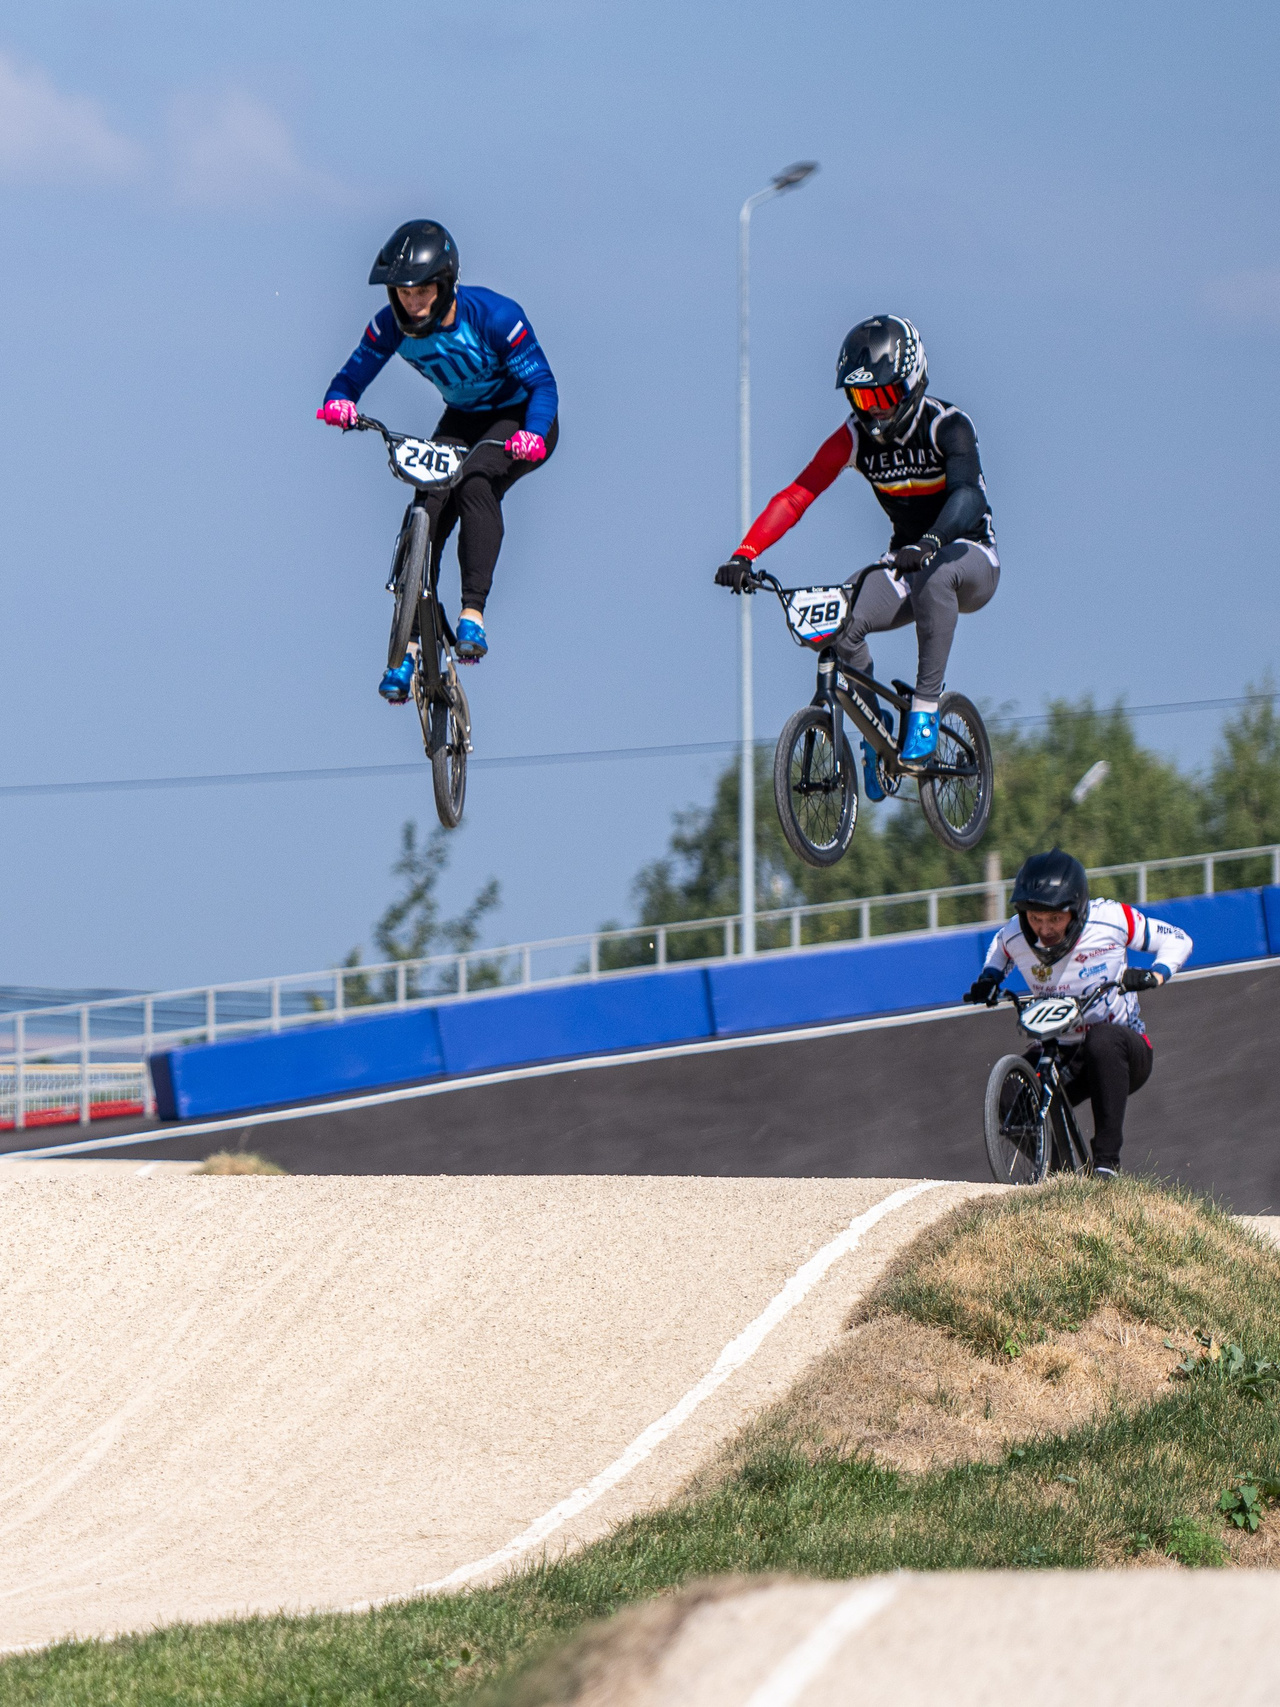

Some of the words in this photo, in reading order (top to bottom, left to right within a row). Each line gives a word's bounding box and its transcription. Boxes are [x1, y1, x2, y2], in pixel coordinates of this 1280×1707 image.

[404, 446, 450, 473] 246
[797, 600, 841, 627] 758
[1028, 1005, 1075, 1024] 119
